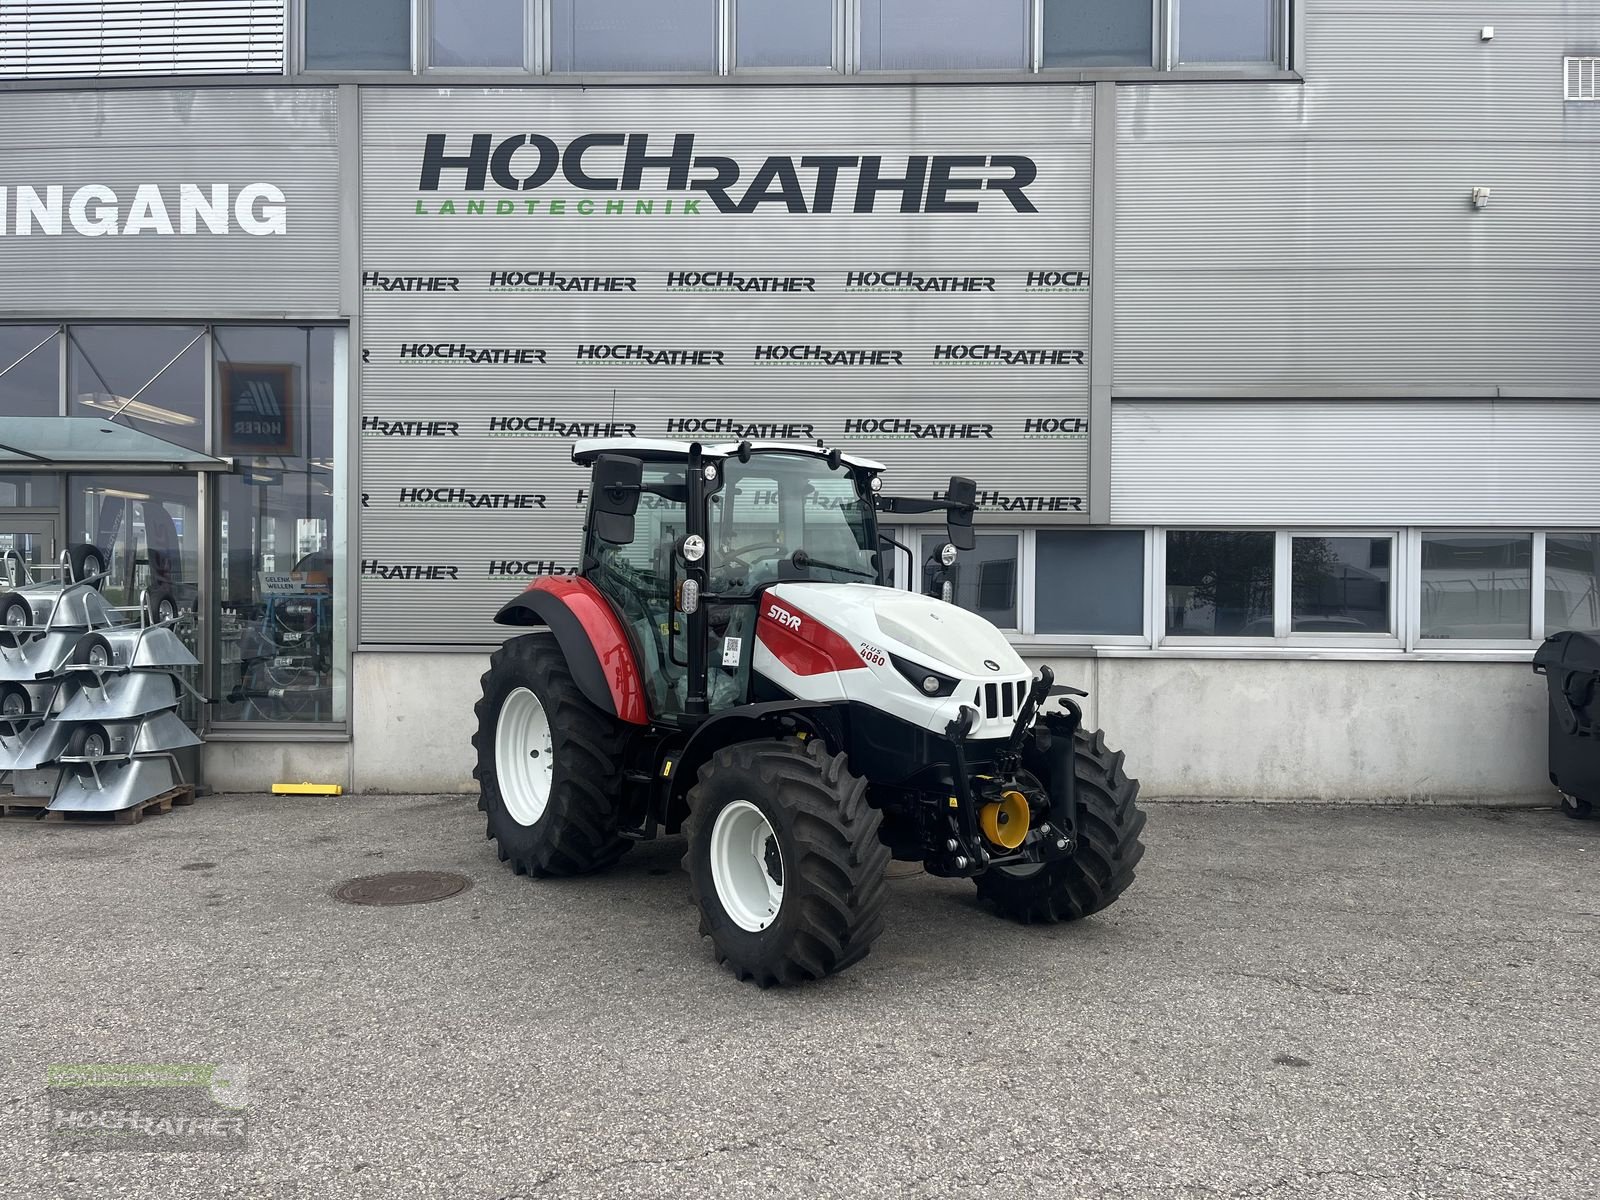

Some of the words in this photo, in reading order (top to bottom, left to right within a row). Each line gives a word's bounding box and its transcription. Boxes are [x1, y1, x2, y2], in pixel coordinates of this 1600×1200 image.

[418, 132, 1039, 214] HOCHRATHER
[415, 199, 701, 215] LANDTECHNIK
[489, 271, 637, 292] HOCHRATHER
[667, 271, 816, 292] HOCHRATHER
[846, 271, 996, 292] HOCHRATHER
[400, 343, 547, 364] HOCHRATHER
[576, 344, 725, 365] HOCHRATHER
[754, 345, 904, 365] HOCHRATHER
[933, 344, 1084, 365] HOCHRATHER
[489, 416, 637, 438] HOCHRATHER
[666, 418, 815, 439] HOCHRATHER
[844, 418, 994, 439] HOCHRATHER
[399, 487, 547, 509] HOCHRATHER
[767, 604, 802, 632] STEYR
[860, 642, 882, 655] PLUS
[860, 648, 886, 667] 4080
